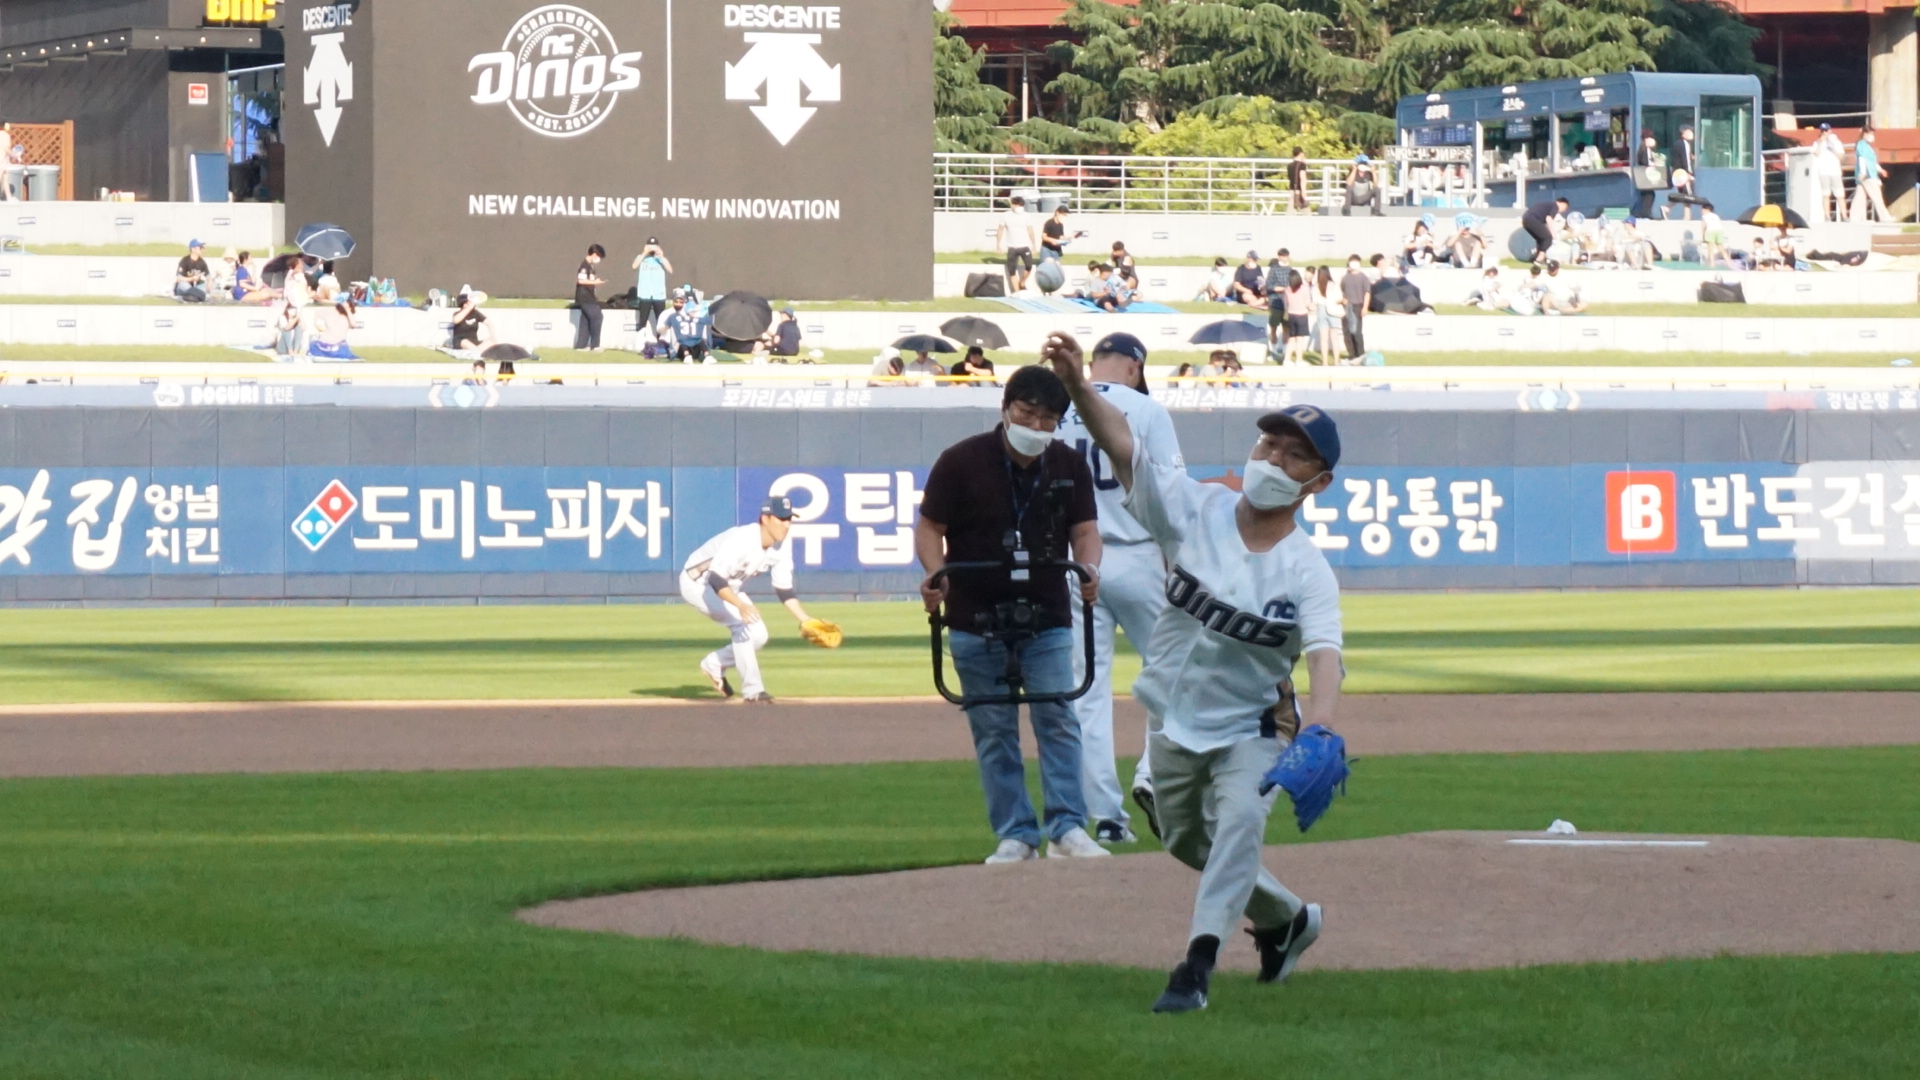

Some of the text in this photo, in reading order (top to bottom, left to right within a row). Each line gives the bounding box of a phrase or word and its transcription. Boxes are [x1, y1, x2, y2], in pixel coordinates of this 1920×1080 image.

[302, 4, 353, 31] DESCENTE
[521, 11, 594, 36] CHANGWON
[724, 4, 841, 28] DESCENTE
[535, 110, 595, 130] EST. 2011
[468, 194, 840, 219] NEW CHALLENGE, NEW INNOVATION
[680, 321, 697, 336] 31
[264, 386, 294, 404] 홈런존
[832, 390, 872, 406] 홈런존
[1826, 391, 1889, 410] 경남은행
[145, 484, 219, 522] 양념
[353, 479, 670, 559] 도미노피자
[1302, 476, 1503, 558] 노랑통닭
[145, 526, 219, 564] 치킨
